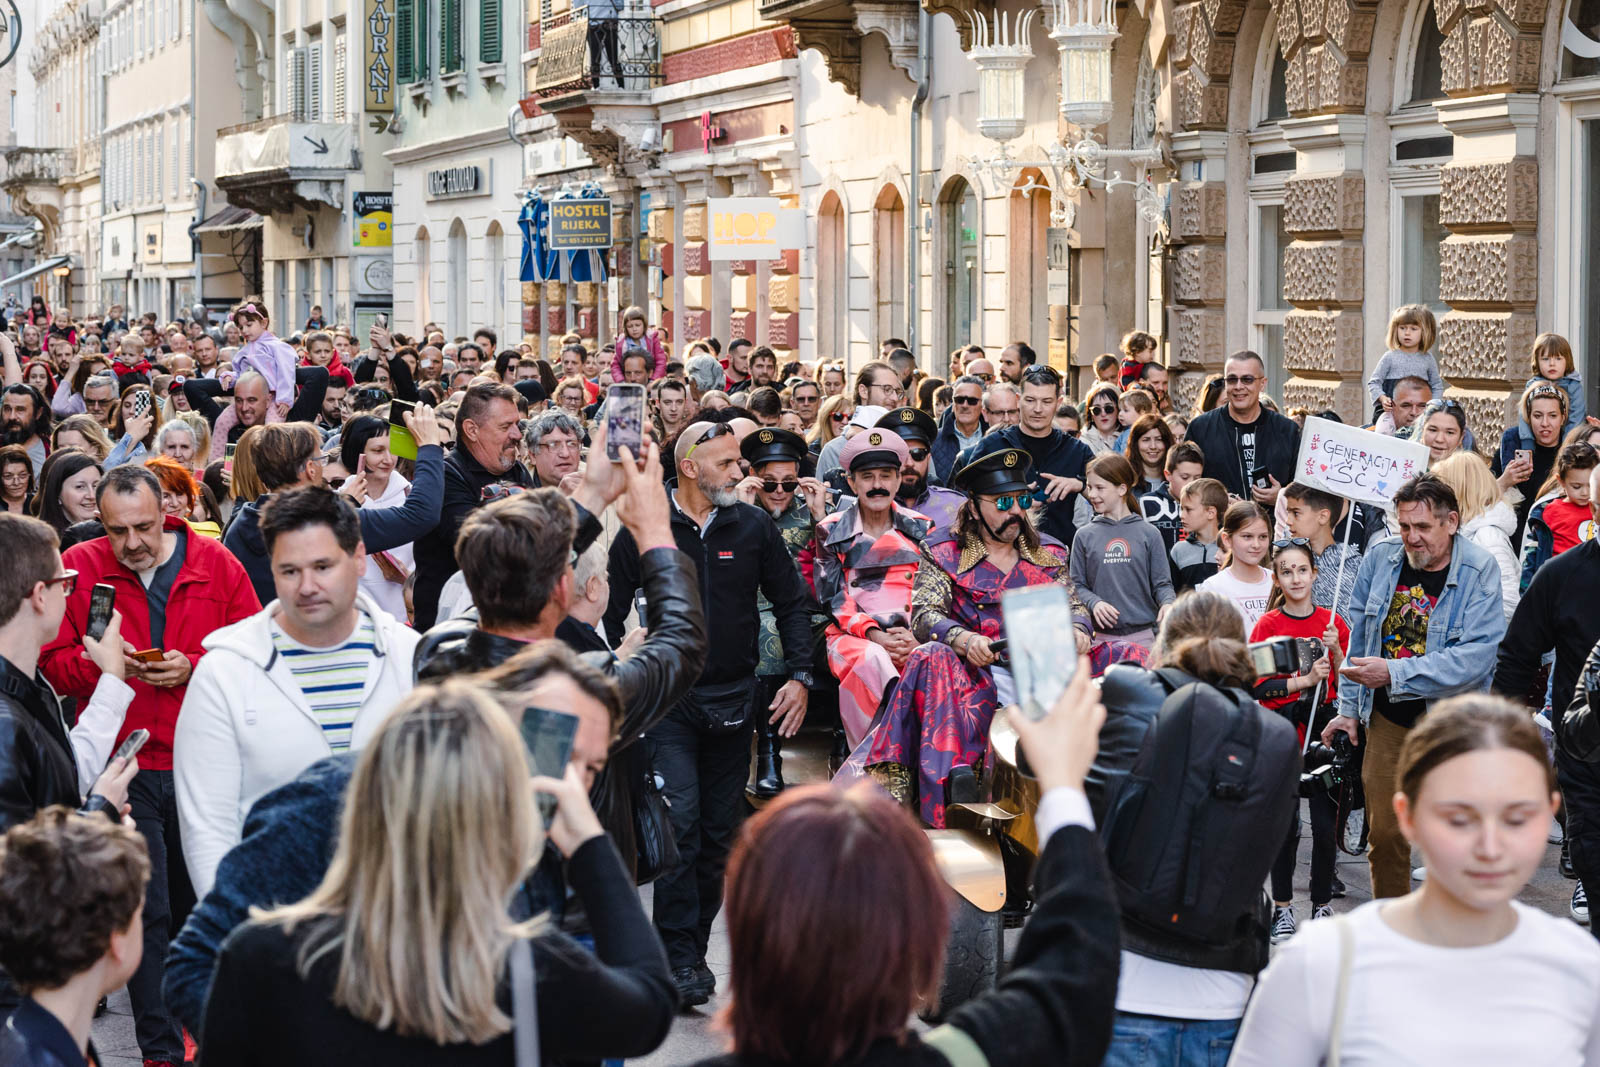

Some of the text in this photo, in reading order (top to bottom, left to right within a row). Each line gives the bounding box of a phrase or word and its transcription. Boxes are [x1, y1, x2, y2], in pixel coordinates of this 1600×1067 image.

[369, 0, 391, 104] AURANT
[553, 204, 608, 217] HOSTEL
[561, 220, 601, 230] RIJEKA
[713, 211, 777, 238] HOP
